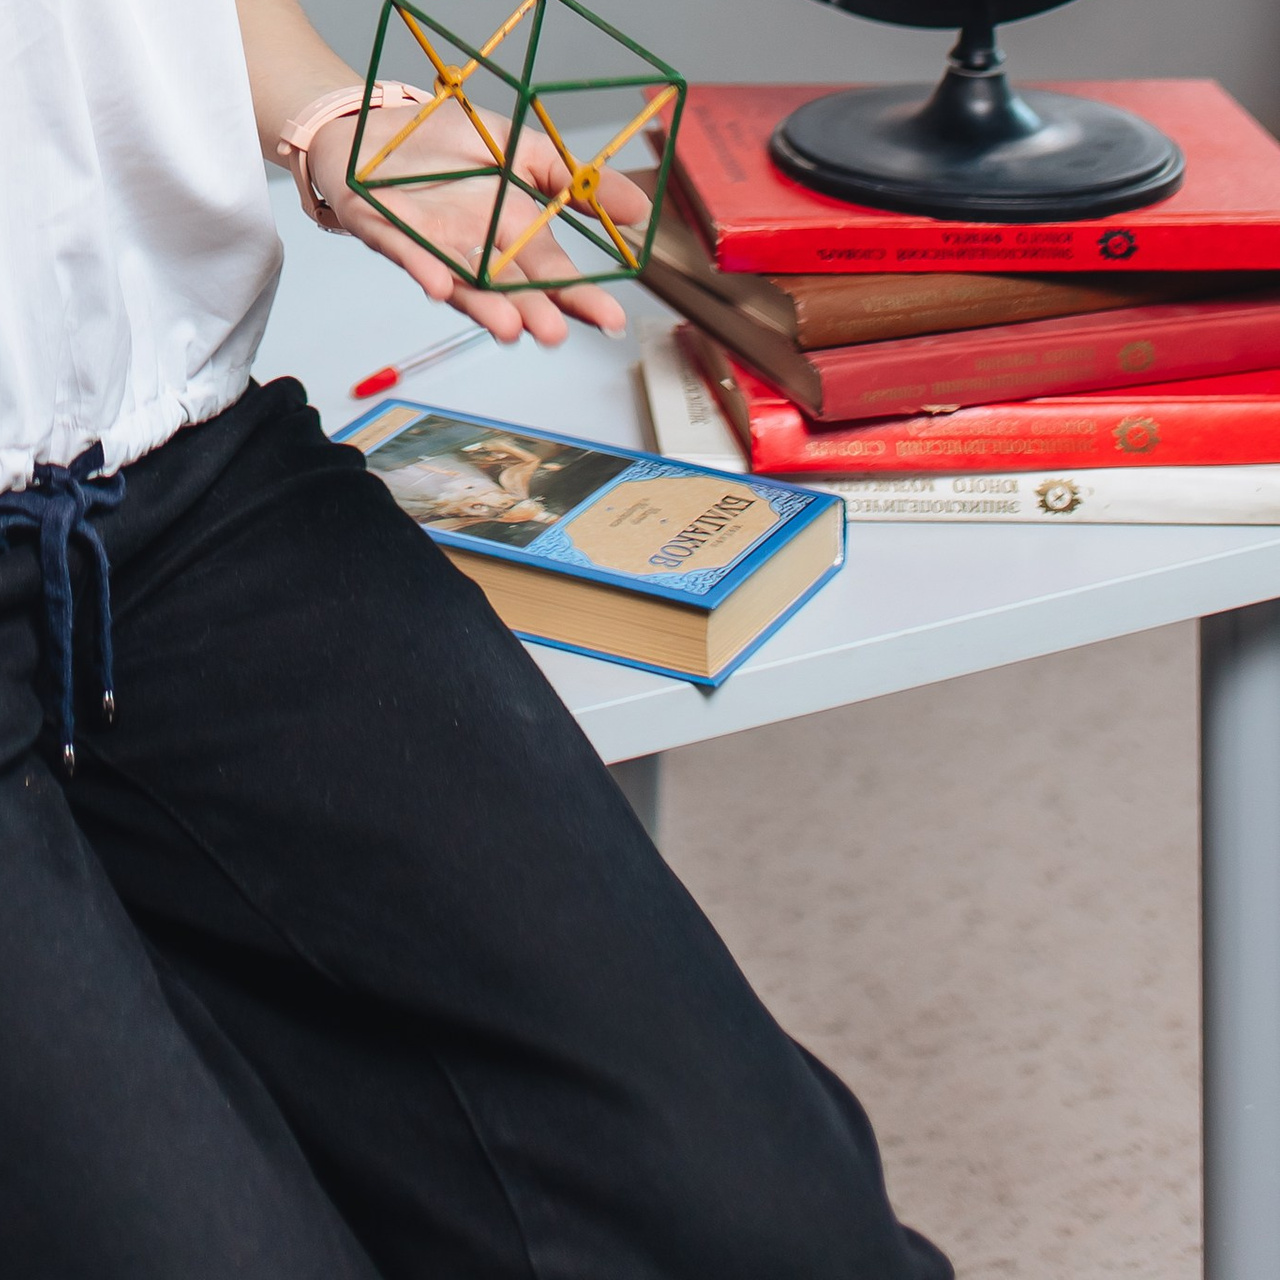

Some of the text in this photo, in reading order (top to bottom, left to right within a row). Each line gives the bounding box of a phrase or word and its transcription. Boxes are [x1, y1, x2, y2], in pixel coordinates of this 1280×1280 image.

[953, 478, 1018, 493] ЮНОГО
[846, 499, 1022, 514] ЭНЦИКЛОПЕДИЧЕС
[648, 495, 757, 570] БУЛГАКОВ
